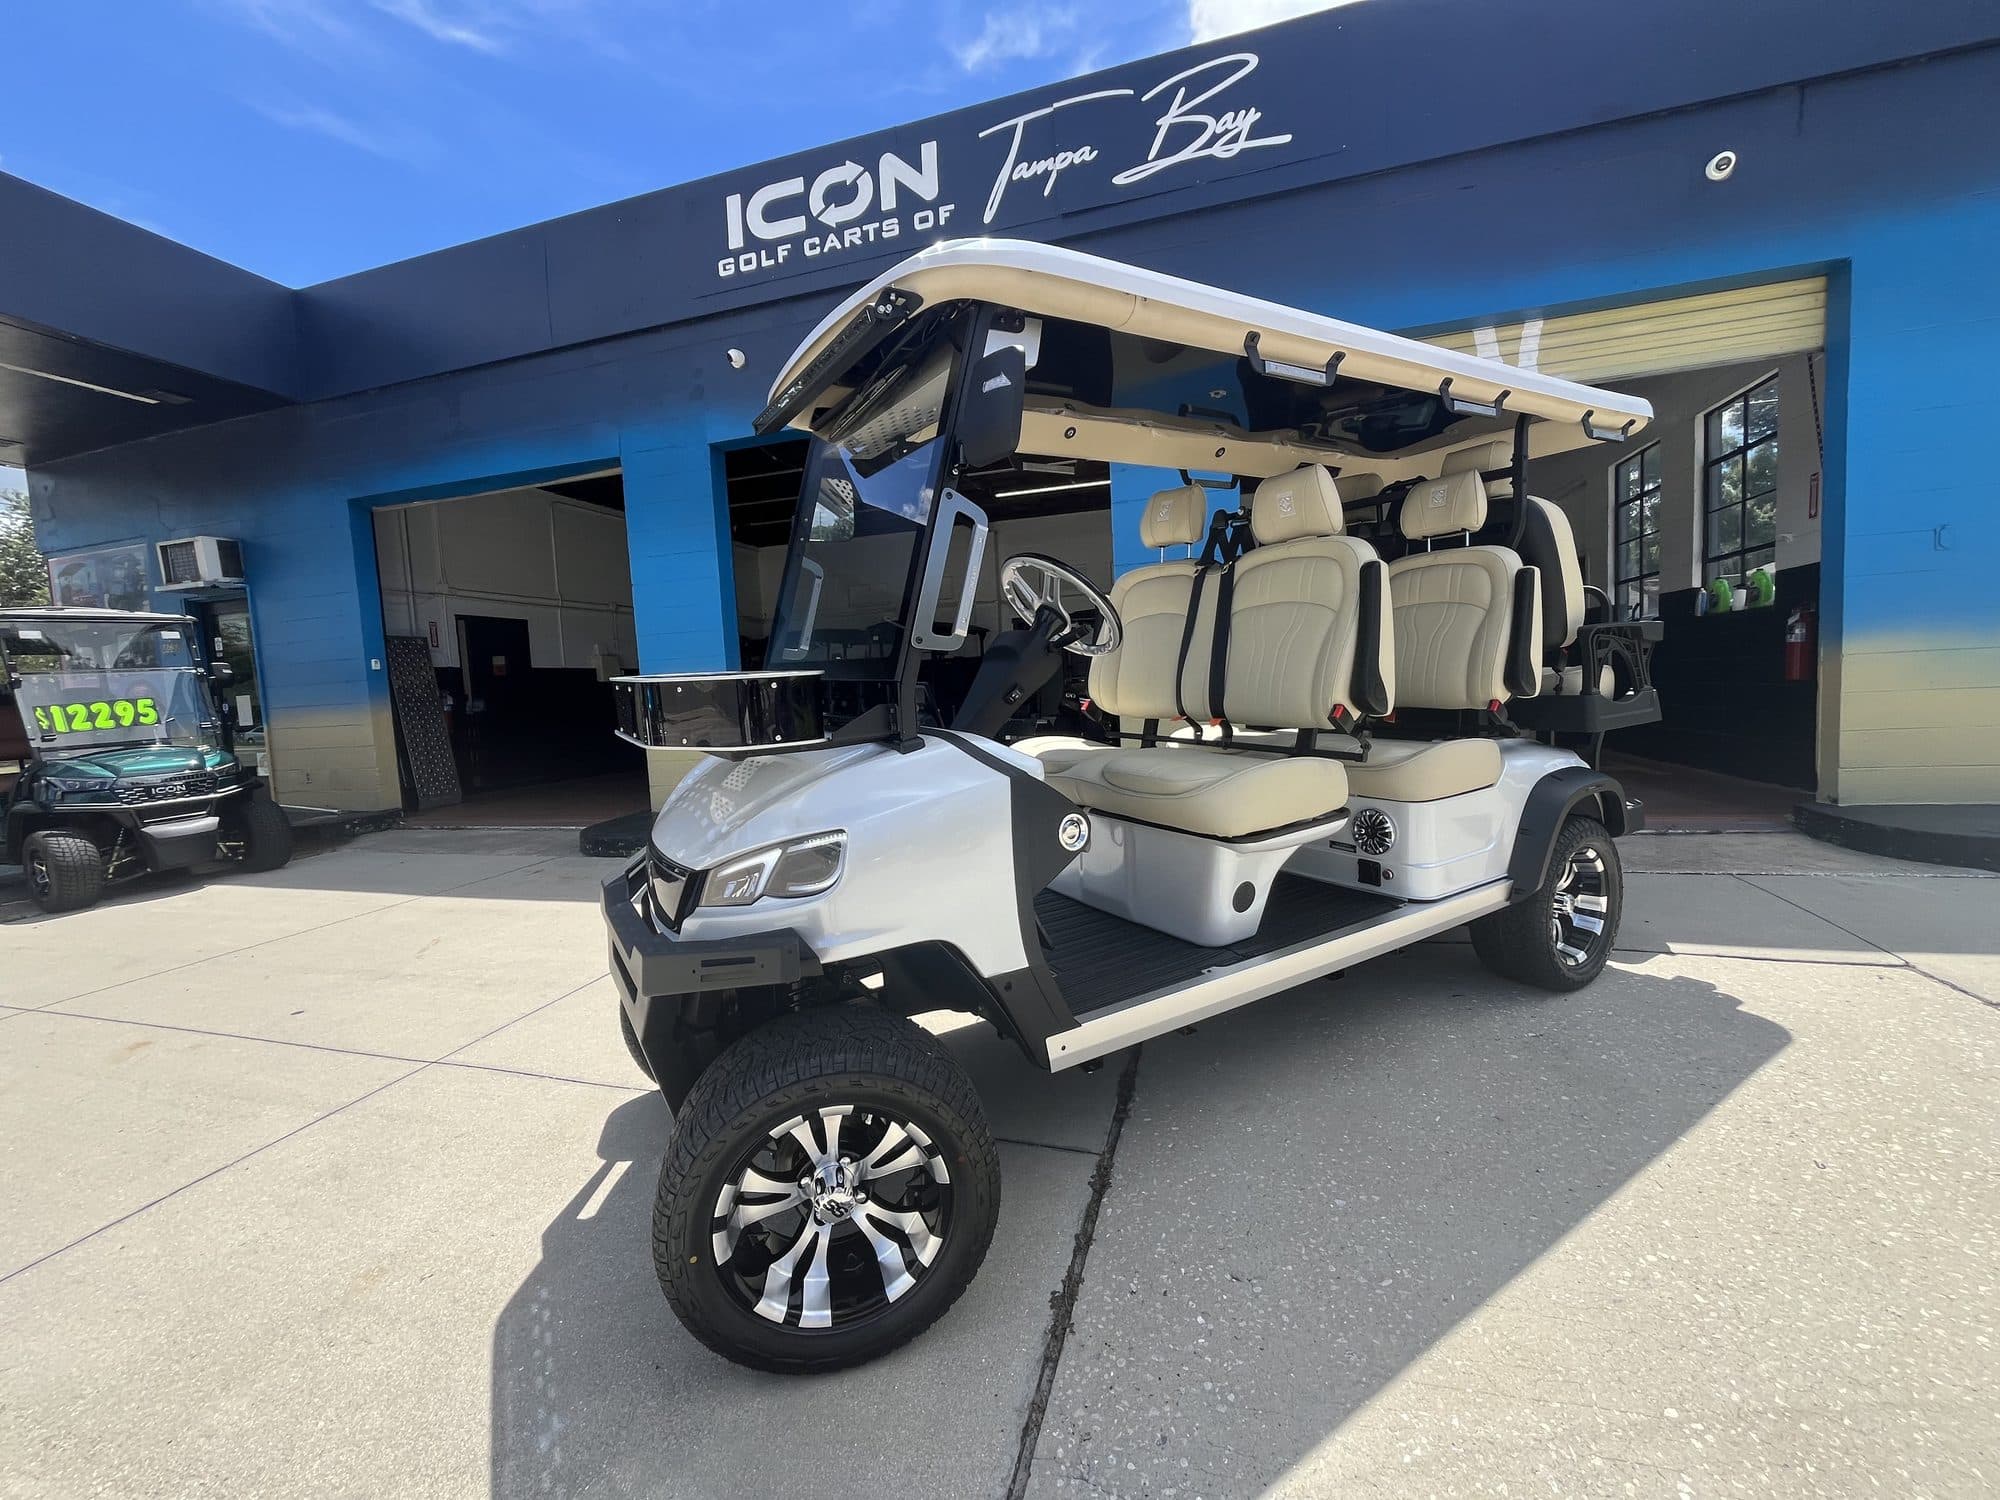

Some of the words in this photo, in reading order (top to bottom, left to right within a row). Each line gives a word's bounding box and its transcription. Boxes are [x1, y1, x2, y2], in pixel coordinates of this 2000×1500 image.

[978, 88, 1134, 224] Tampa
[1111, 53, 1293, 185] Bay
[726, 140, 940, 249] ICON
[718, 244, 791, 277] GOLF
[803, 218, 900, 255] CARTS
[913, 203, 956, 231] OF
[35, 698, 158, 733] $12295
[151, 784, 186, 795] ICON
